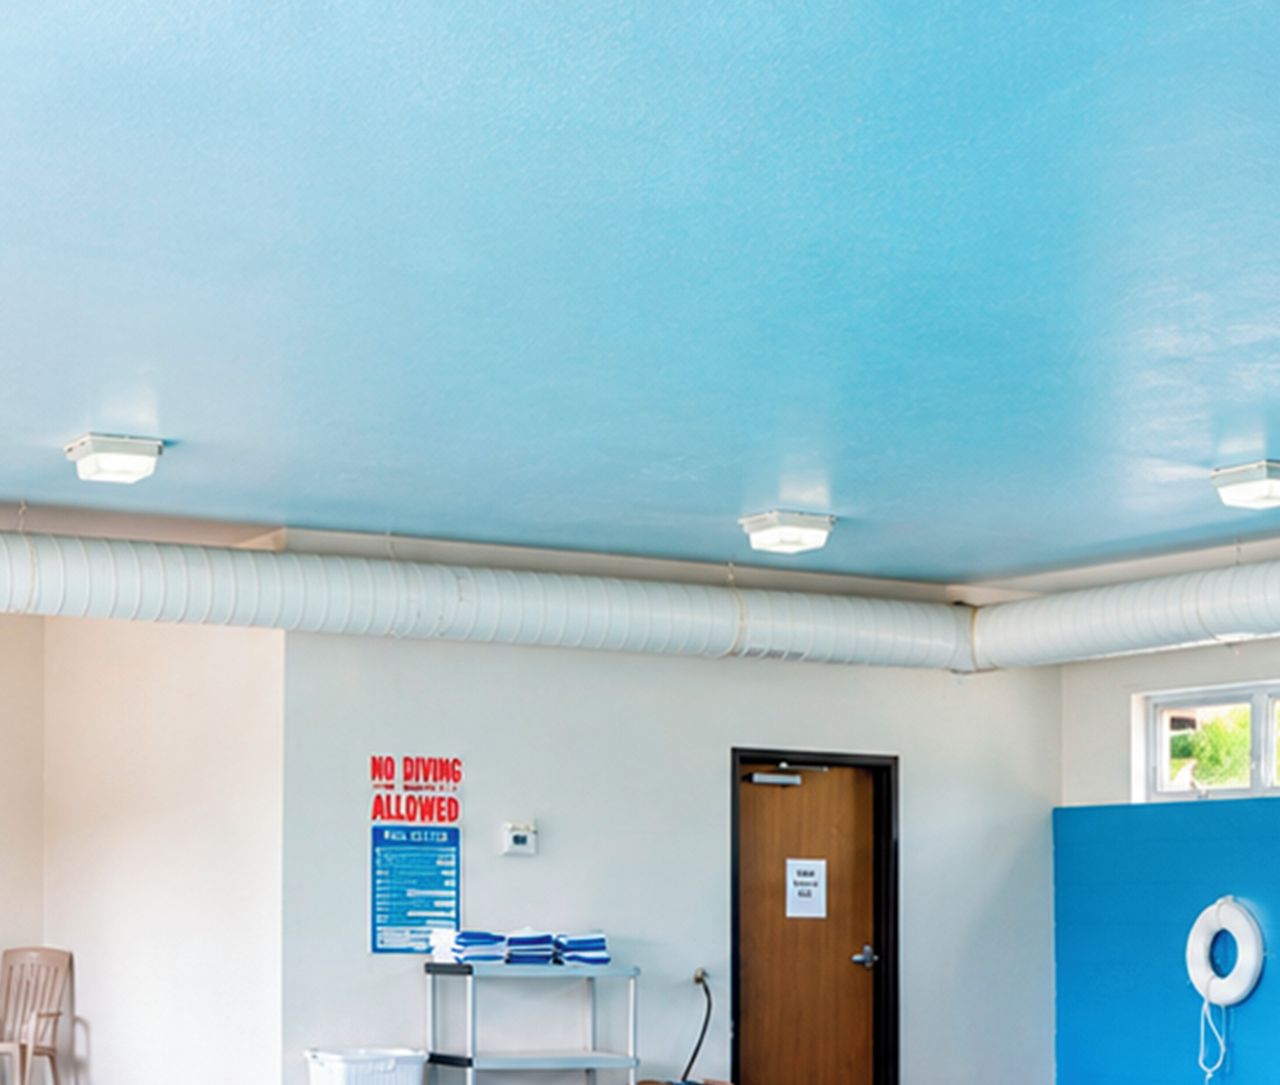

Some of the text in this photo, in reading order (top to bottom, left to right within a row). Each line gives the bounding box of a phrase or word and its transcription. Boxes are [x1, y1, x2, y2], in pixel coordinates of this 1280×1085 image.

[370, 755, 463, 783] NO DIVING
[371, 793, 460, 824] ALLOWED
